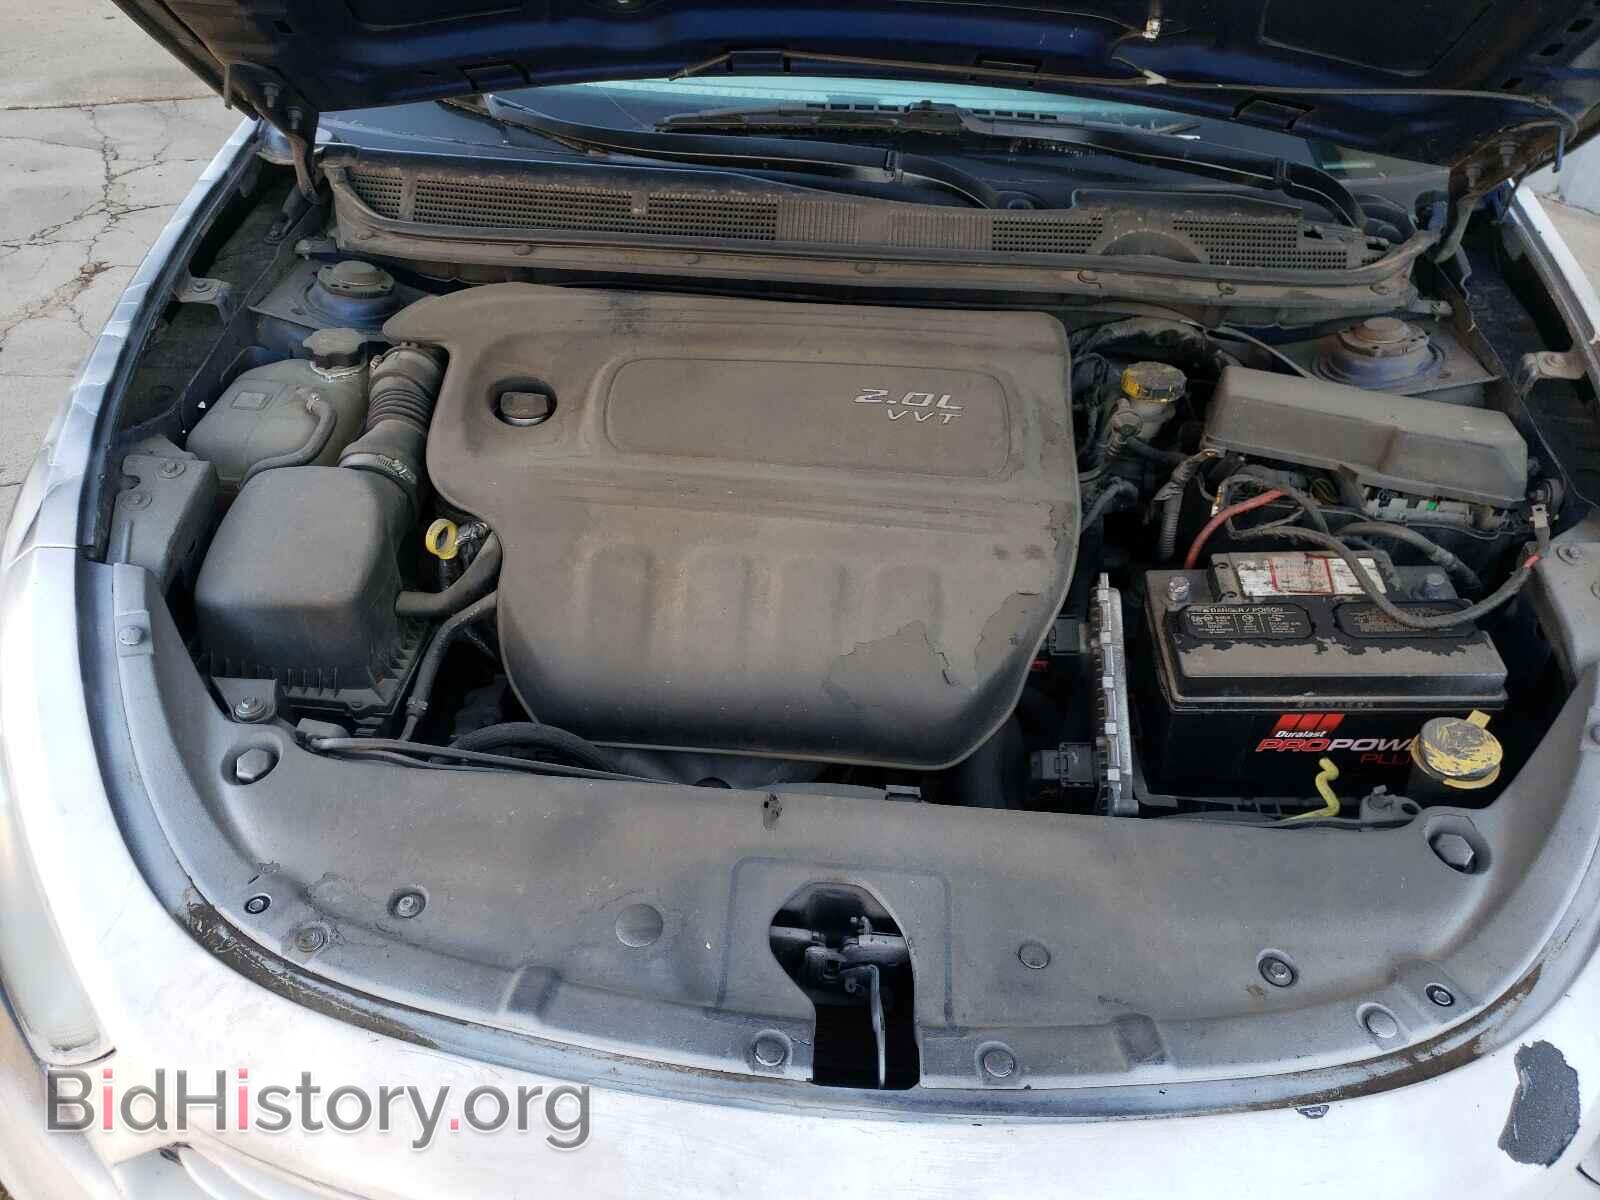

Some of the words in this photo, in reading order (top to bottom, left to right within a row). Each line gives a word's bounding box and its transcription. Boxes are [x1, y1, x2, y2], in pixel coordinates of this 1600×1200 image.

[854, 388, 964, 410] 2.0L
[887, 408, 962, 424] VVT
[1274, 730, 1327, 738] Duralast
[1255, 738, 1411, 753] PROPOW
[1360, 752, 1411, 765] PLU
